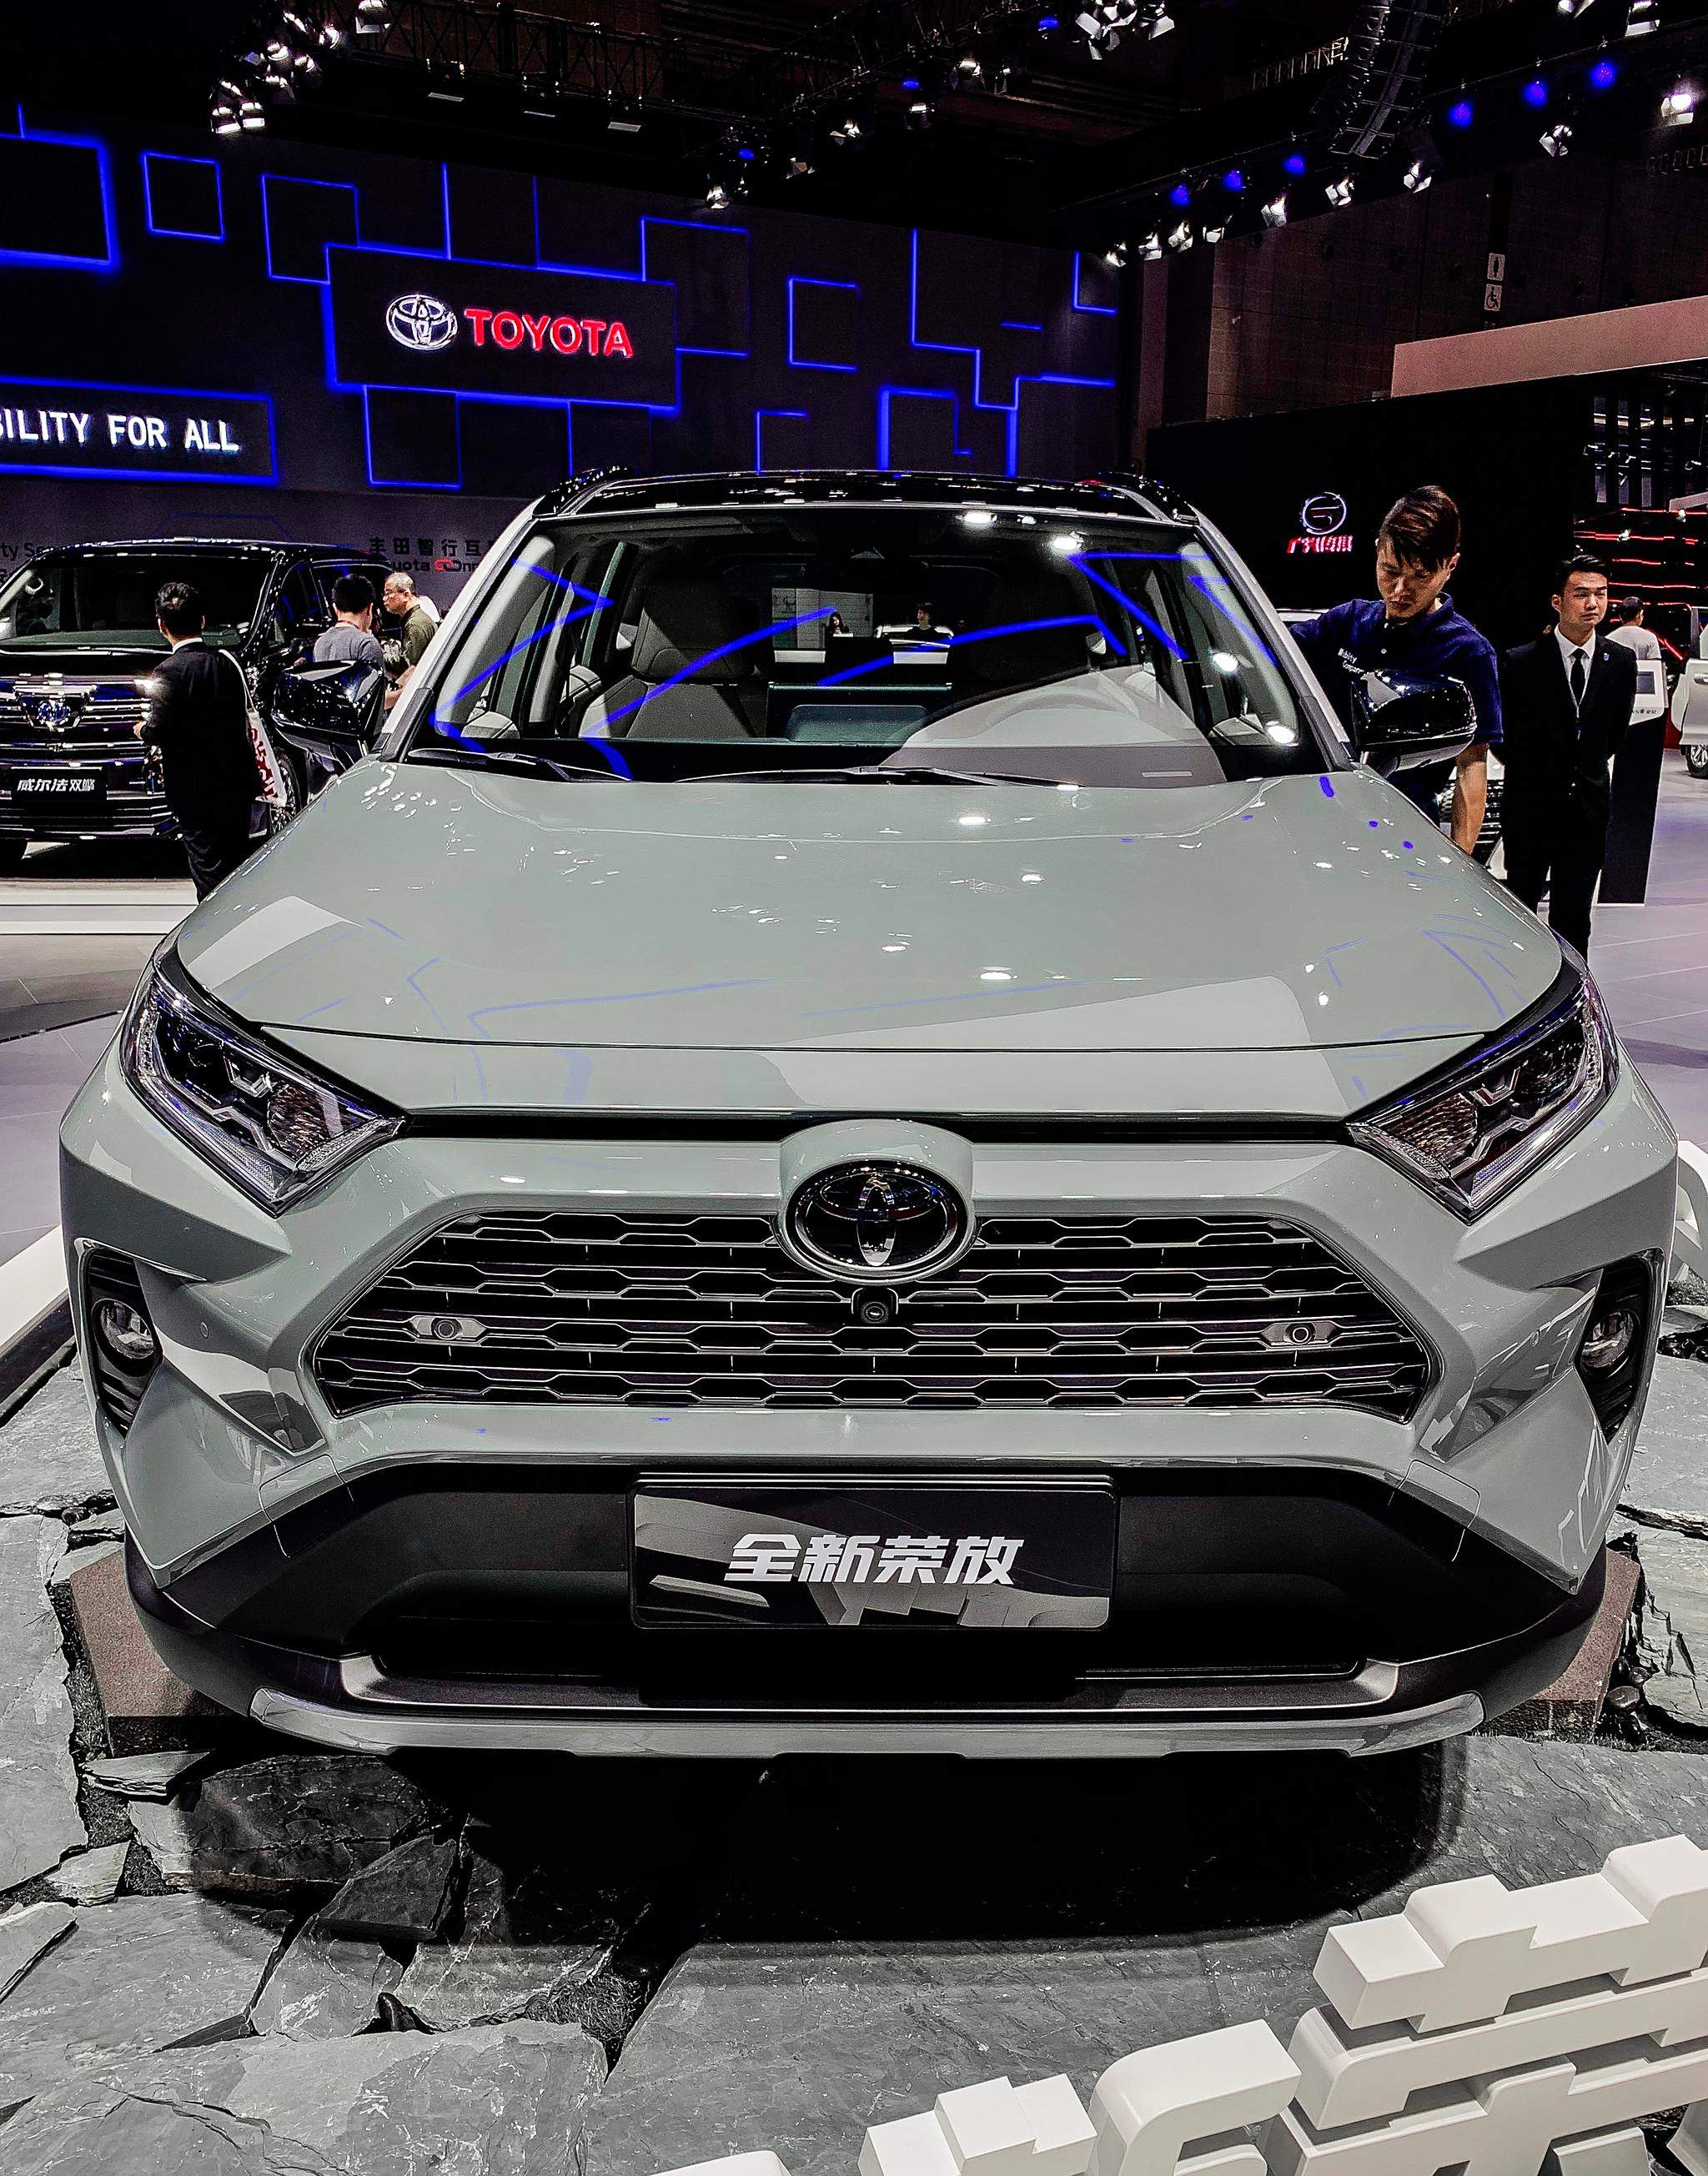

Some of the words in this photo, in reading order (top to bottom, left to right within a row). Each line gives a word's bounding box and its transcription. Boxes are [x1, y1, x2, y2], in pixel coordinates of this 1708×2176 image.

[465, 308, 634, 359] TOYOTA
[0, 408, 89, 444] ILITY
[107, 413, 167, 448] FOR
[184, 418, 239, 451] ALL
[369, 536, 494, 556] 丰田智行互
[724, 1533, 1024, 1586] 全新荣放
